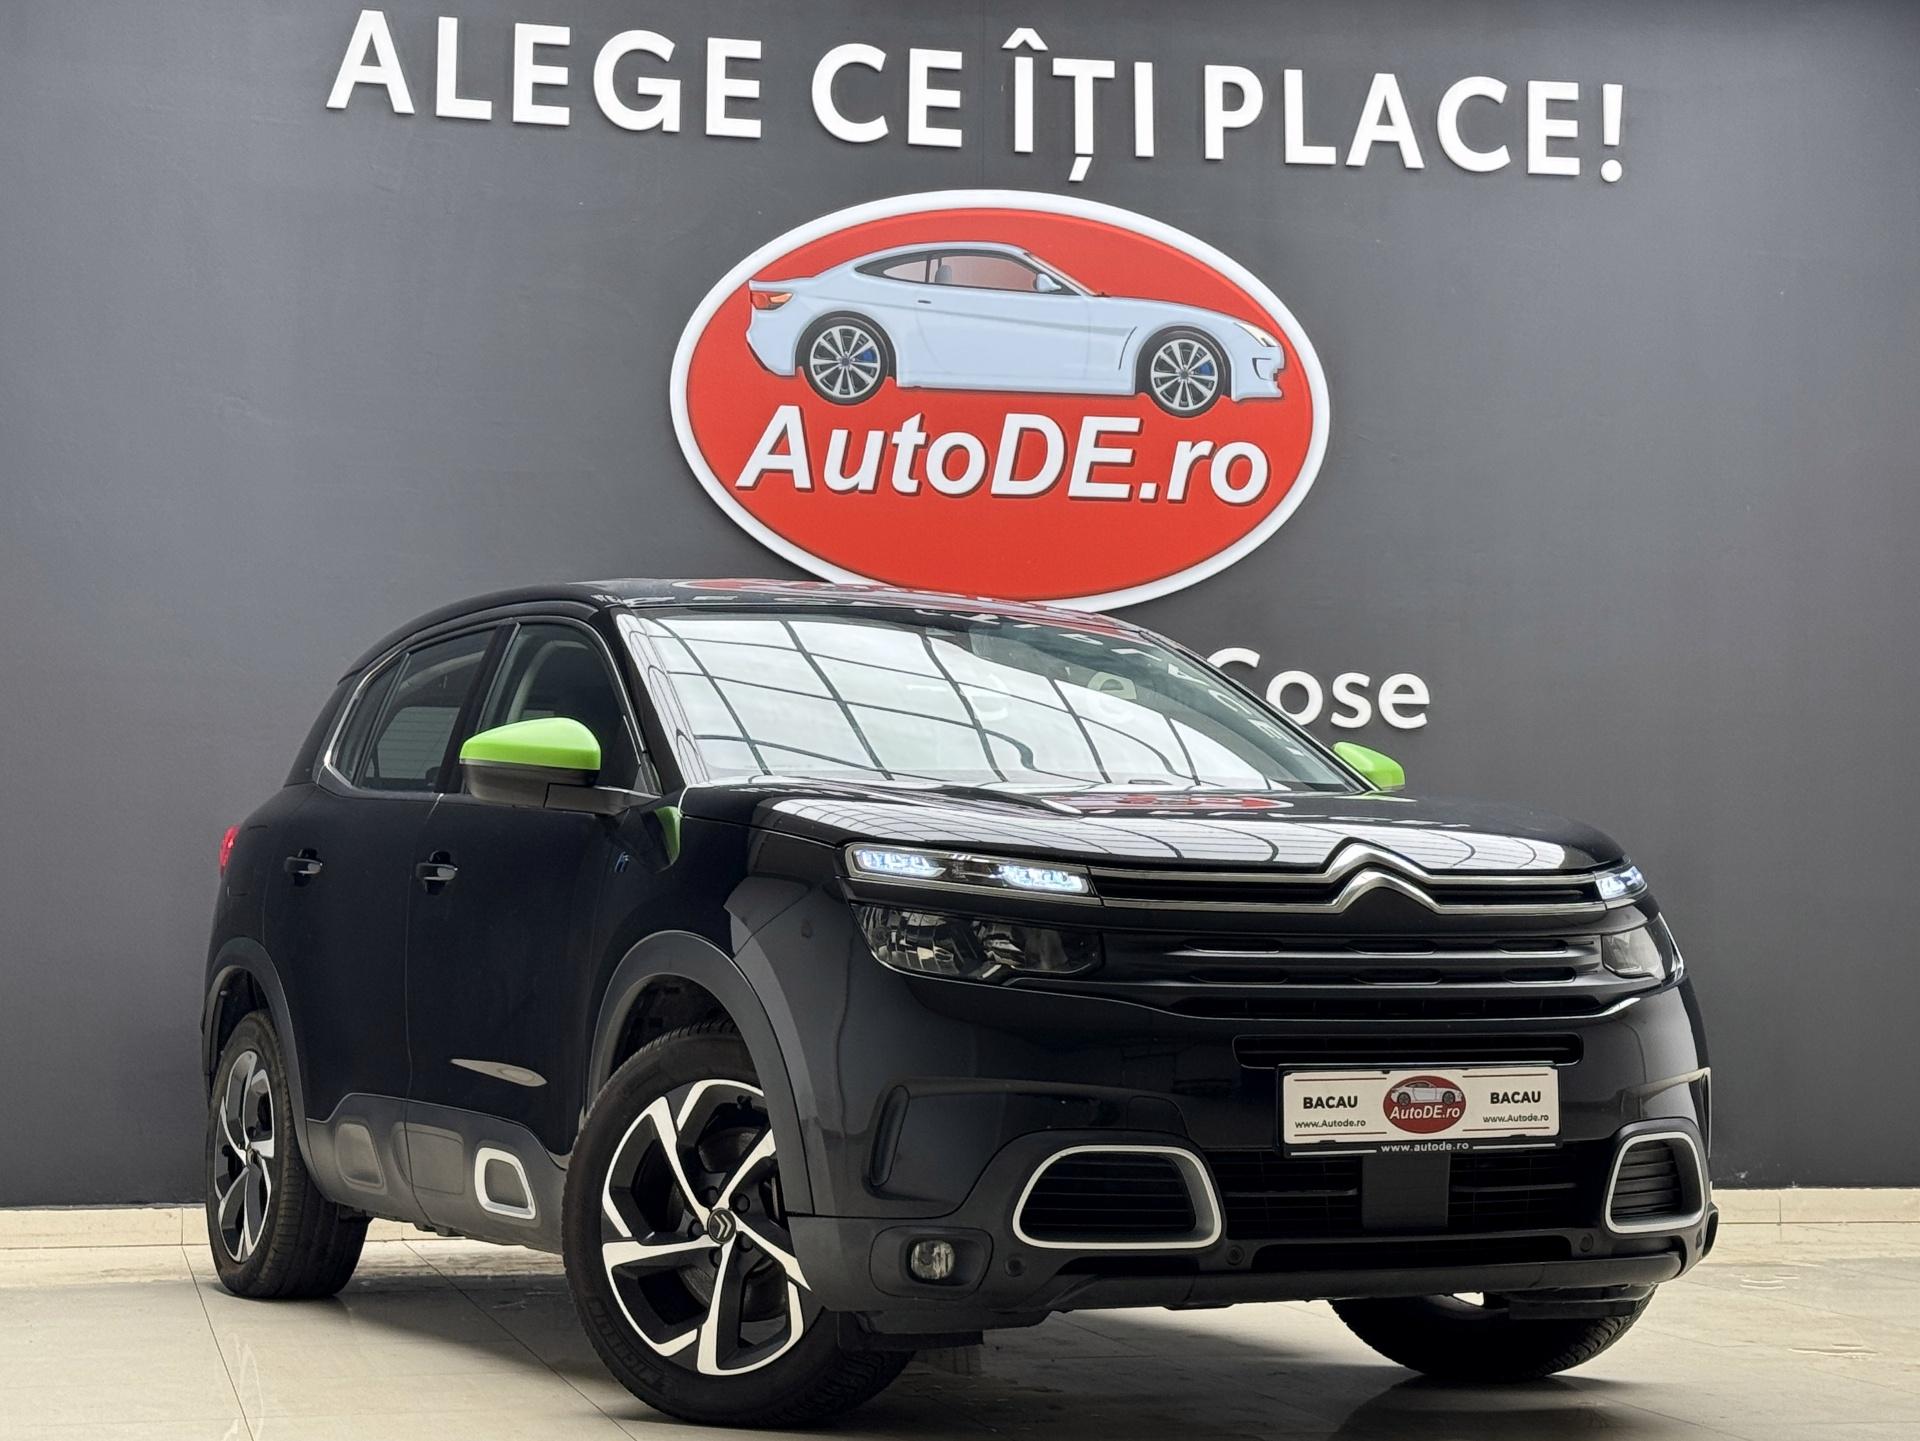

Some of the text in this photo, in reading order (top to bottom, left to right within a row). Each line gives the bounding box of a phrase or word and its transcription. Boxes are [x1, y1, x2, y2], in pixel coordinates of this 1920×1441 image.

[326, 9, 762, 138] ALEGE
[811, 43, 963, 148] CE
[1203, 64, 1625, 183] PLACE!
[735, 404, 1269, 505] AutoDE.ro
[1302, 1095, 1358, 1109] BACAU
[1489, 1091, 1542, 1104] BACAU
[1389, 1104, 1461, 1120] AutoDE.ro
[1482, 1113, 1549, 1123] www.Autode.ro
[1294, 1118, 1366, 1129] www.Autode.ro
[1380, 1141, 1469, 1153] www.autode.ro
